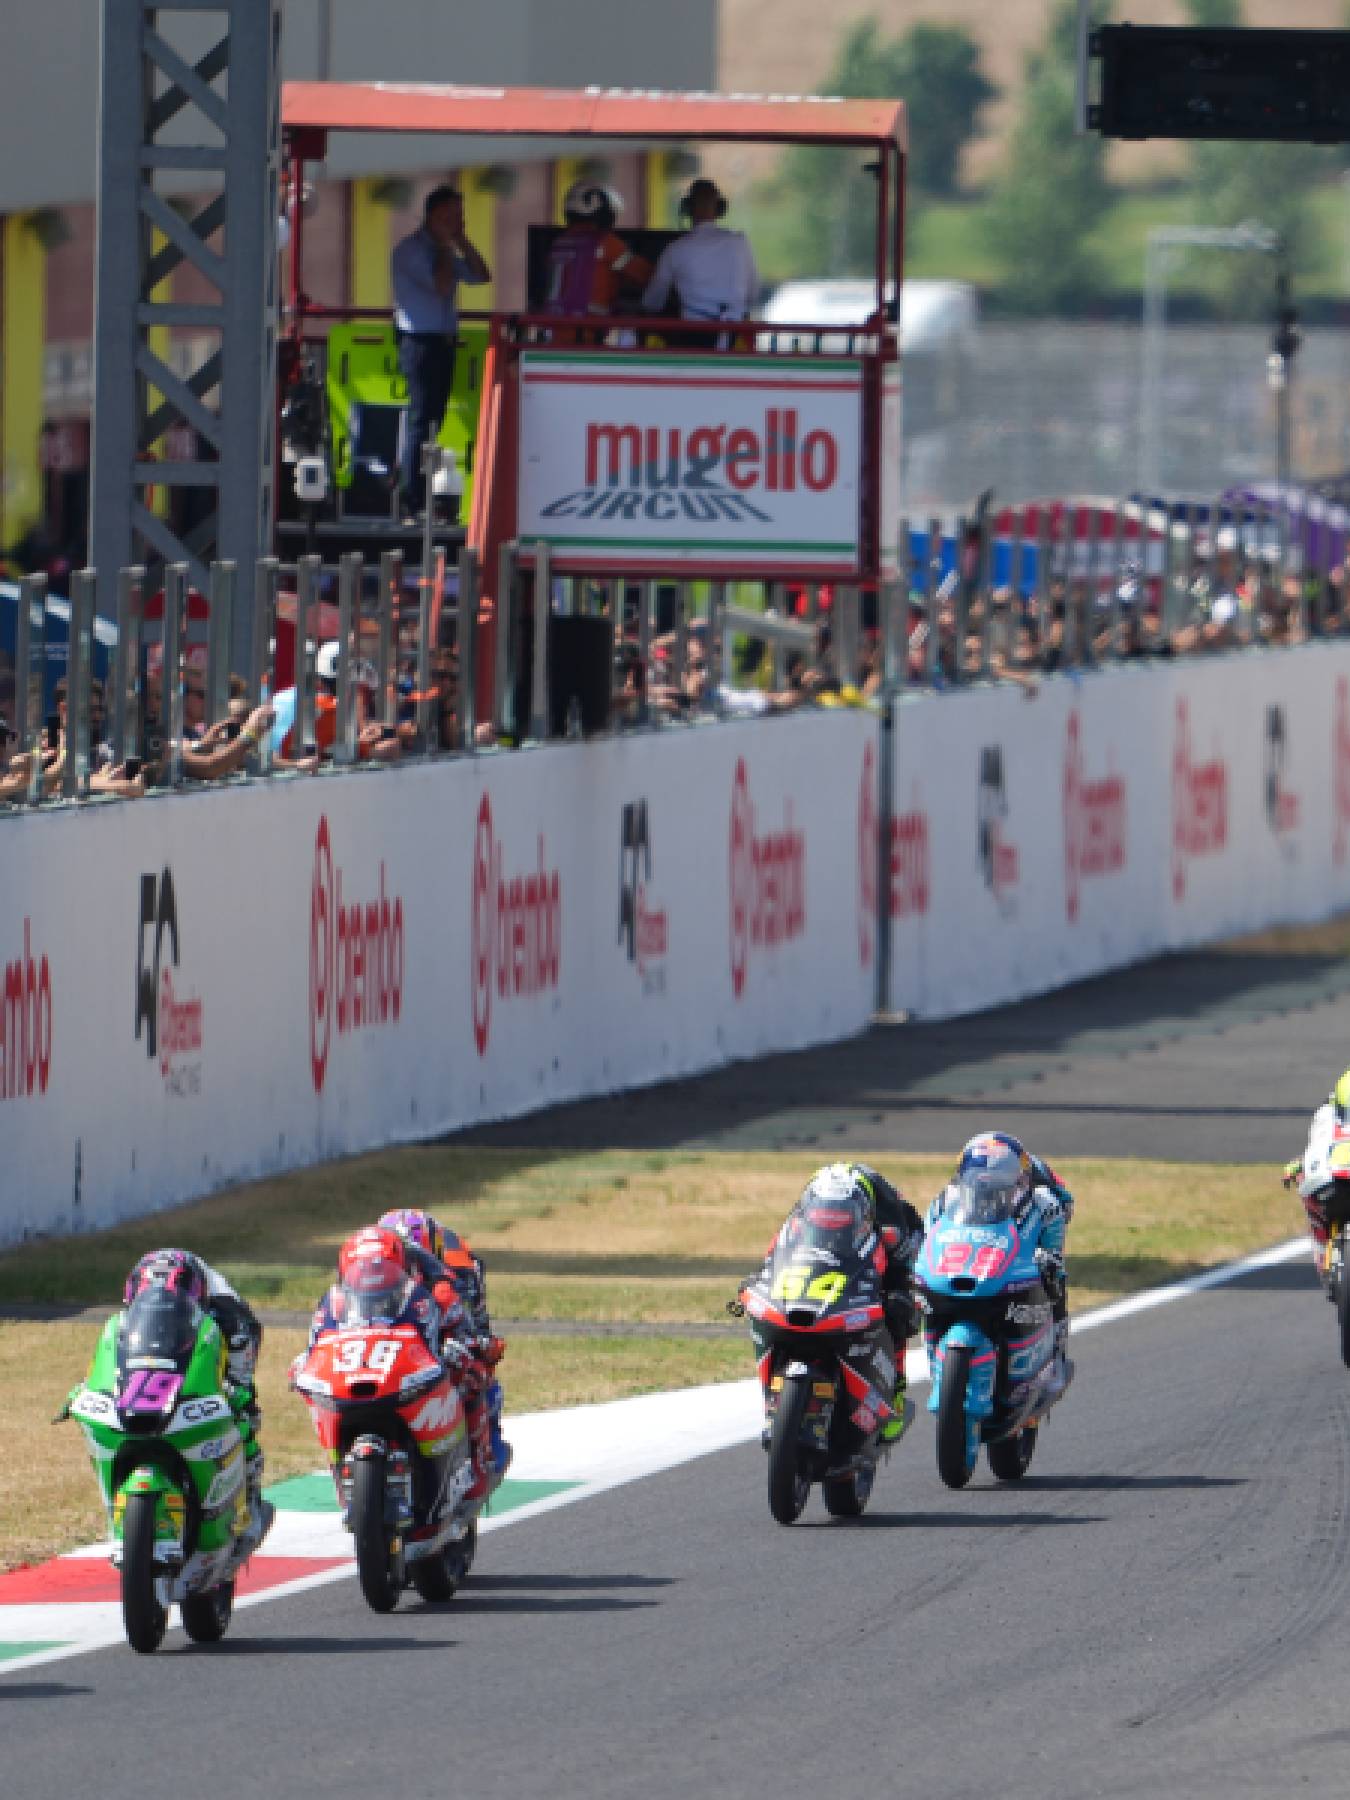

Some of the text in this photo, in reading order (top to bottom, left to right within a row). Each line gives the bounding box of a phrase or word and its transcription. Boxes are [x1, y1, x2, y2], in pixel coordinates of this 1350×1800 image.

[585, 407, 839, 492] mugello
[539, 491, 776, 523] CIRCUIT
[0, 916, 52, 1099] mbo
[118, 1369, 184, 1412] 19
